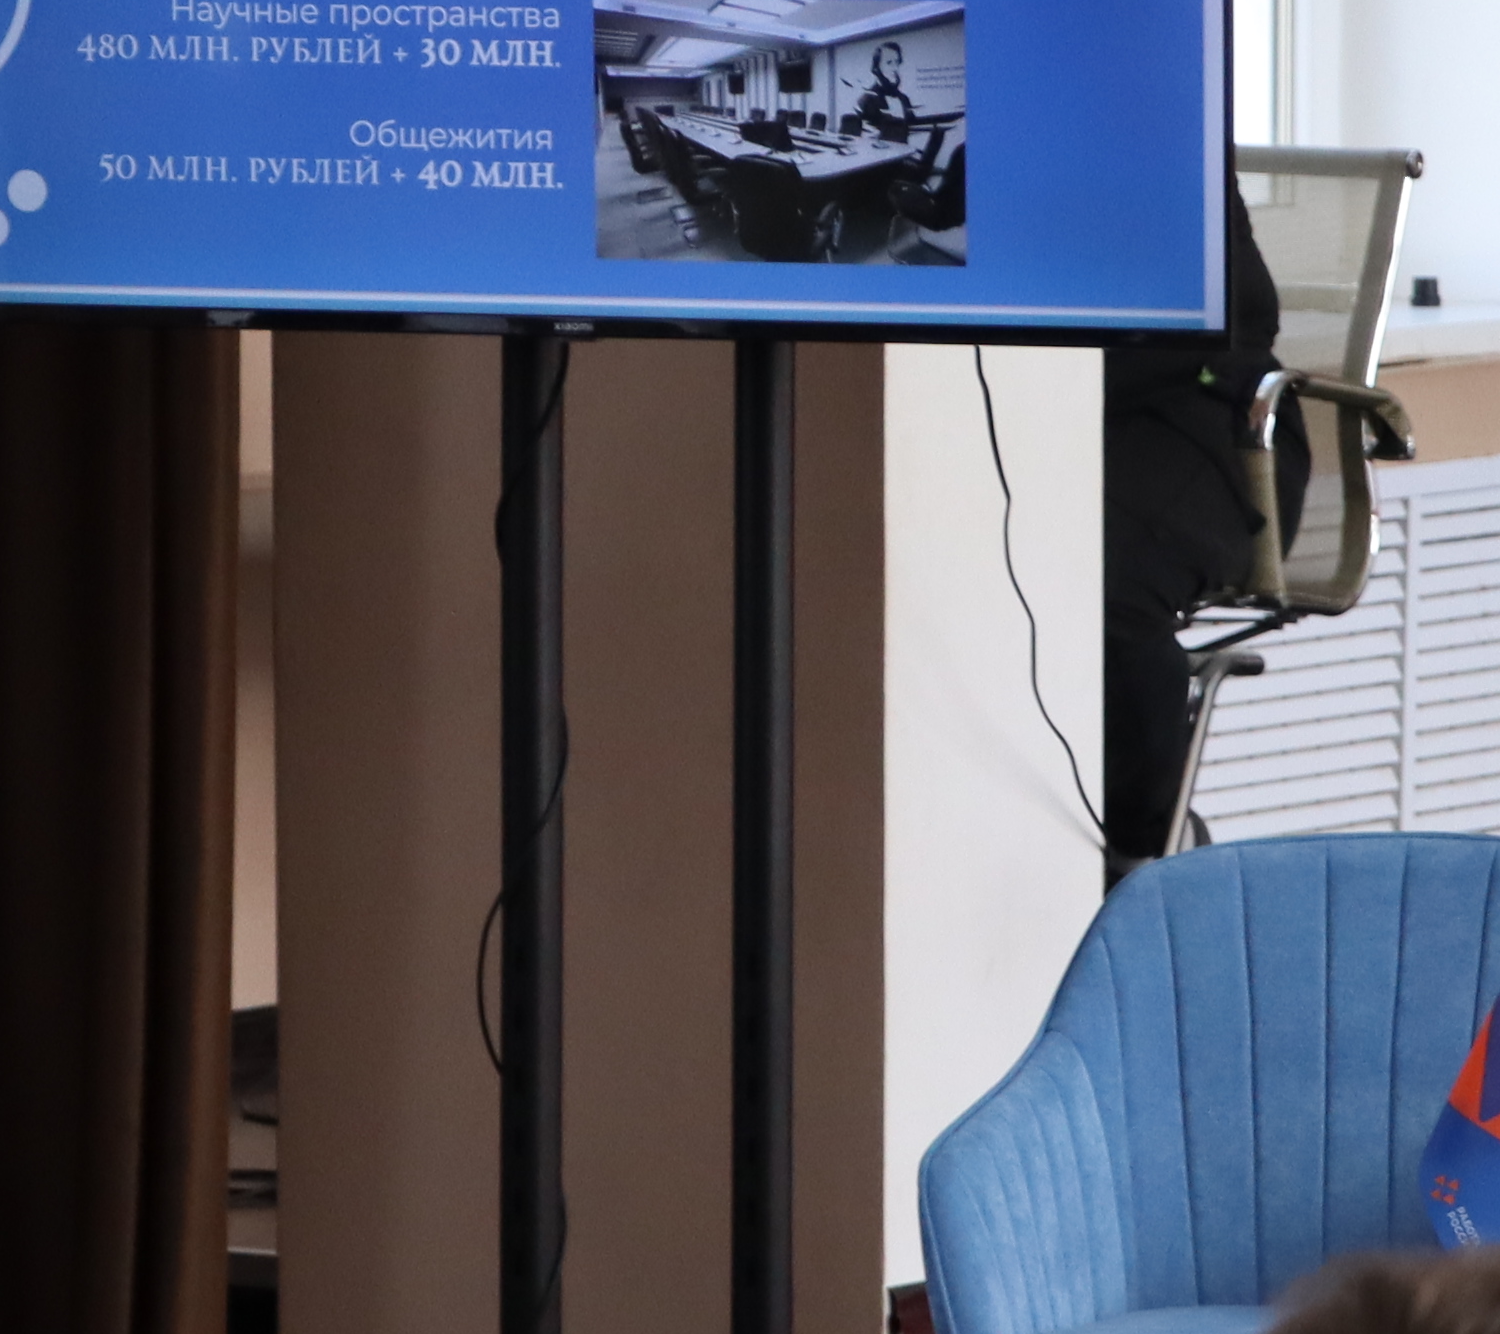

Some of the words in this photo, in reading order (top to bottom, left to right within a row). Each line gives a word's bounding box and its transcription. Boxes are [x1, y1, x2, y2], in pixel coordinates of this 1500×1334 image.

[329, 3, 560, 31] пространства
[77, 34, 138, 62] 480
[148, 35, 239, 62] МЛН.
[251, 33, 381, 64] РУБЛЕЙ
[393, 47, 408, 61] +
[420, 38, 461, 67] 30
[470, 39, 561, 68] МЛН.
[349, 119, 553, 151] Общежития
[99, 154, 135, 183] 50
[147, 155, 237, 182] МЛН.
[250, 153, 380, 184] РУБЛЕЙ
[392, 168, 406, 182] +
[417, 160, 463, 189] 40
[471, 161, 564, 189] МЛН.
